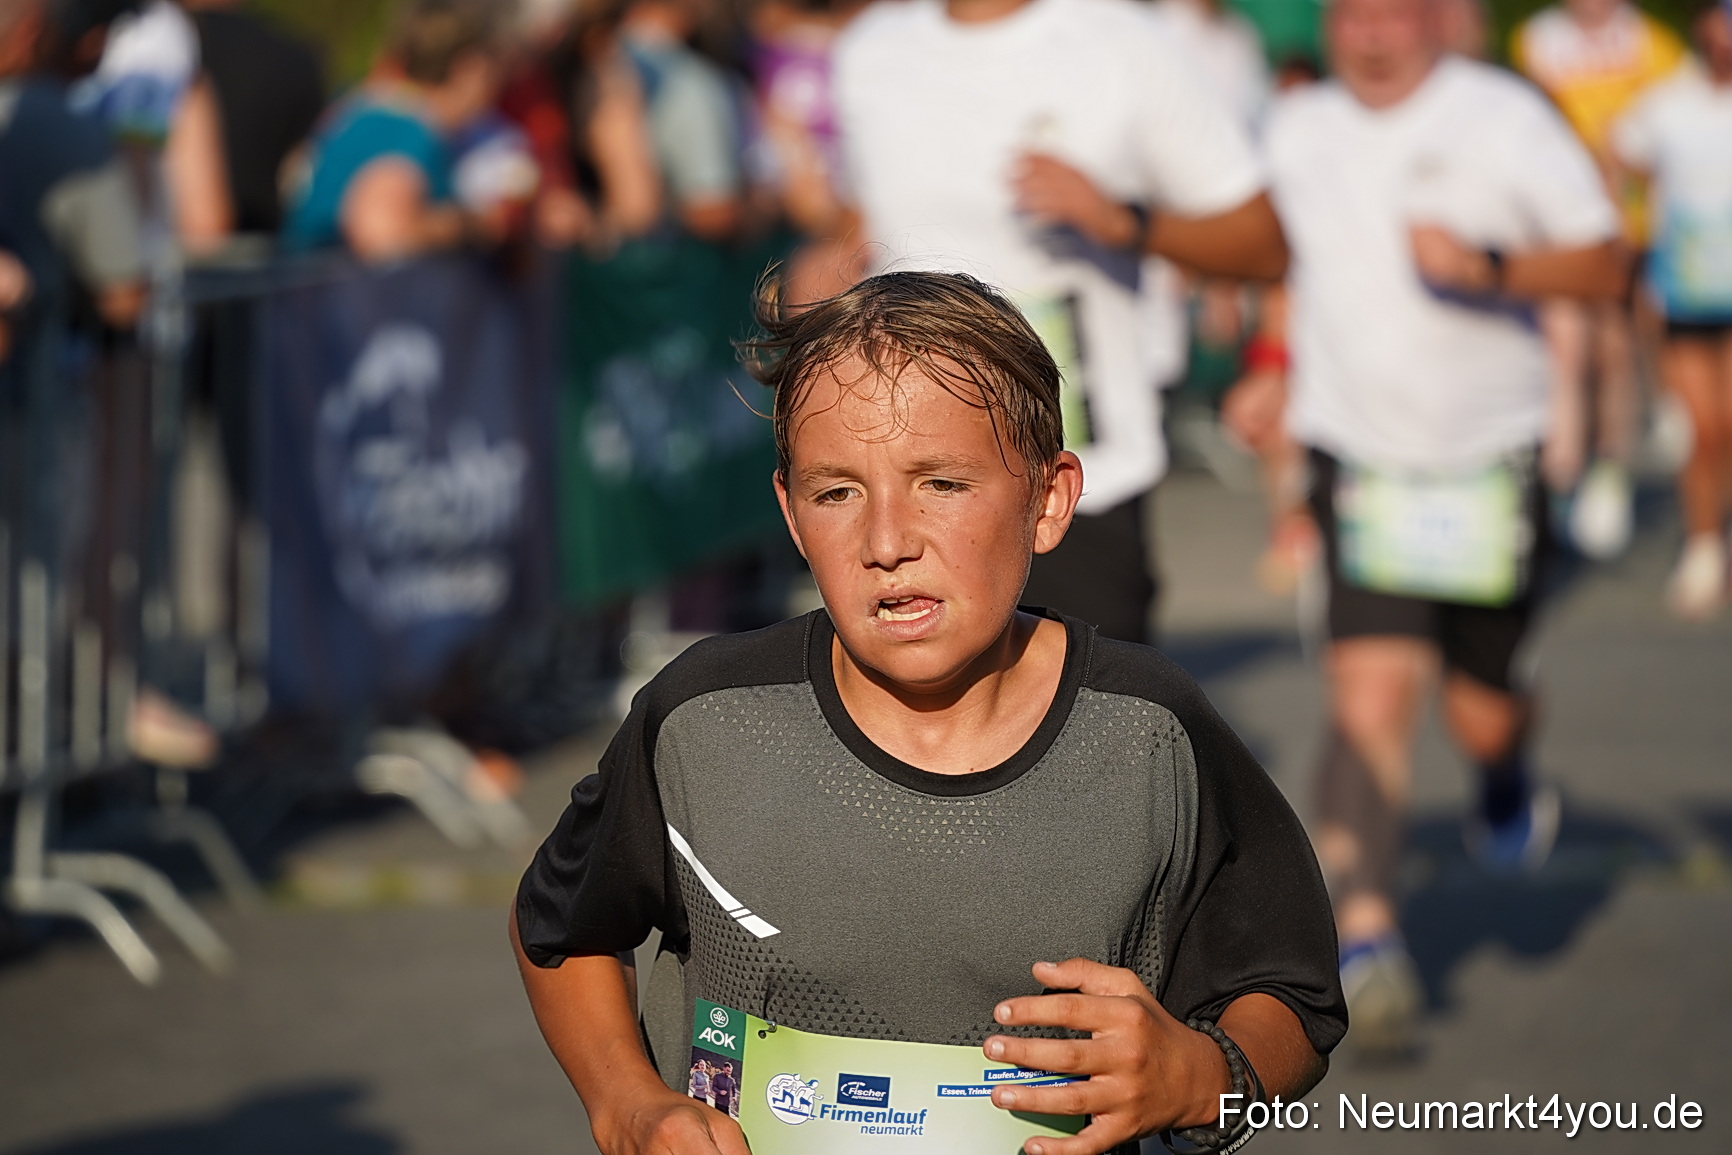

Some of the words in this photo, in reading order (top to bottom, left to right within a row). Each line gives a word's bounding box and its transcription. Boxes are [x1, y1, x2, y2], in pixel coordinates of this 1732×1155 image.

[698, 1027, 737, 1051] AOK
[987, 1071, 1016, 1080] Laufen,
[1017, 1070, 1044, 1079] Joggen,
[848, 1086, 887, 1098] Fischer
[941, 1087, 967, 1096] Essen,
[967, 1087, 994, 1096] Trinke
[819, 1103, 928, 1125] Firmenlauf
[860, 1124, 924, 1136] neumarkt
